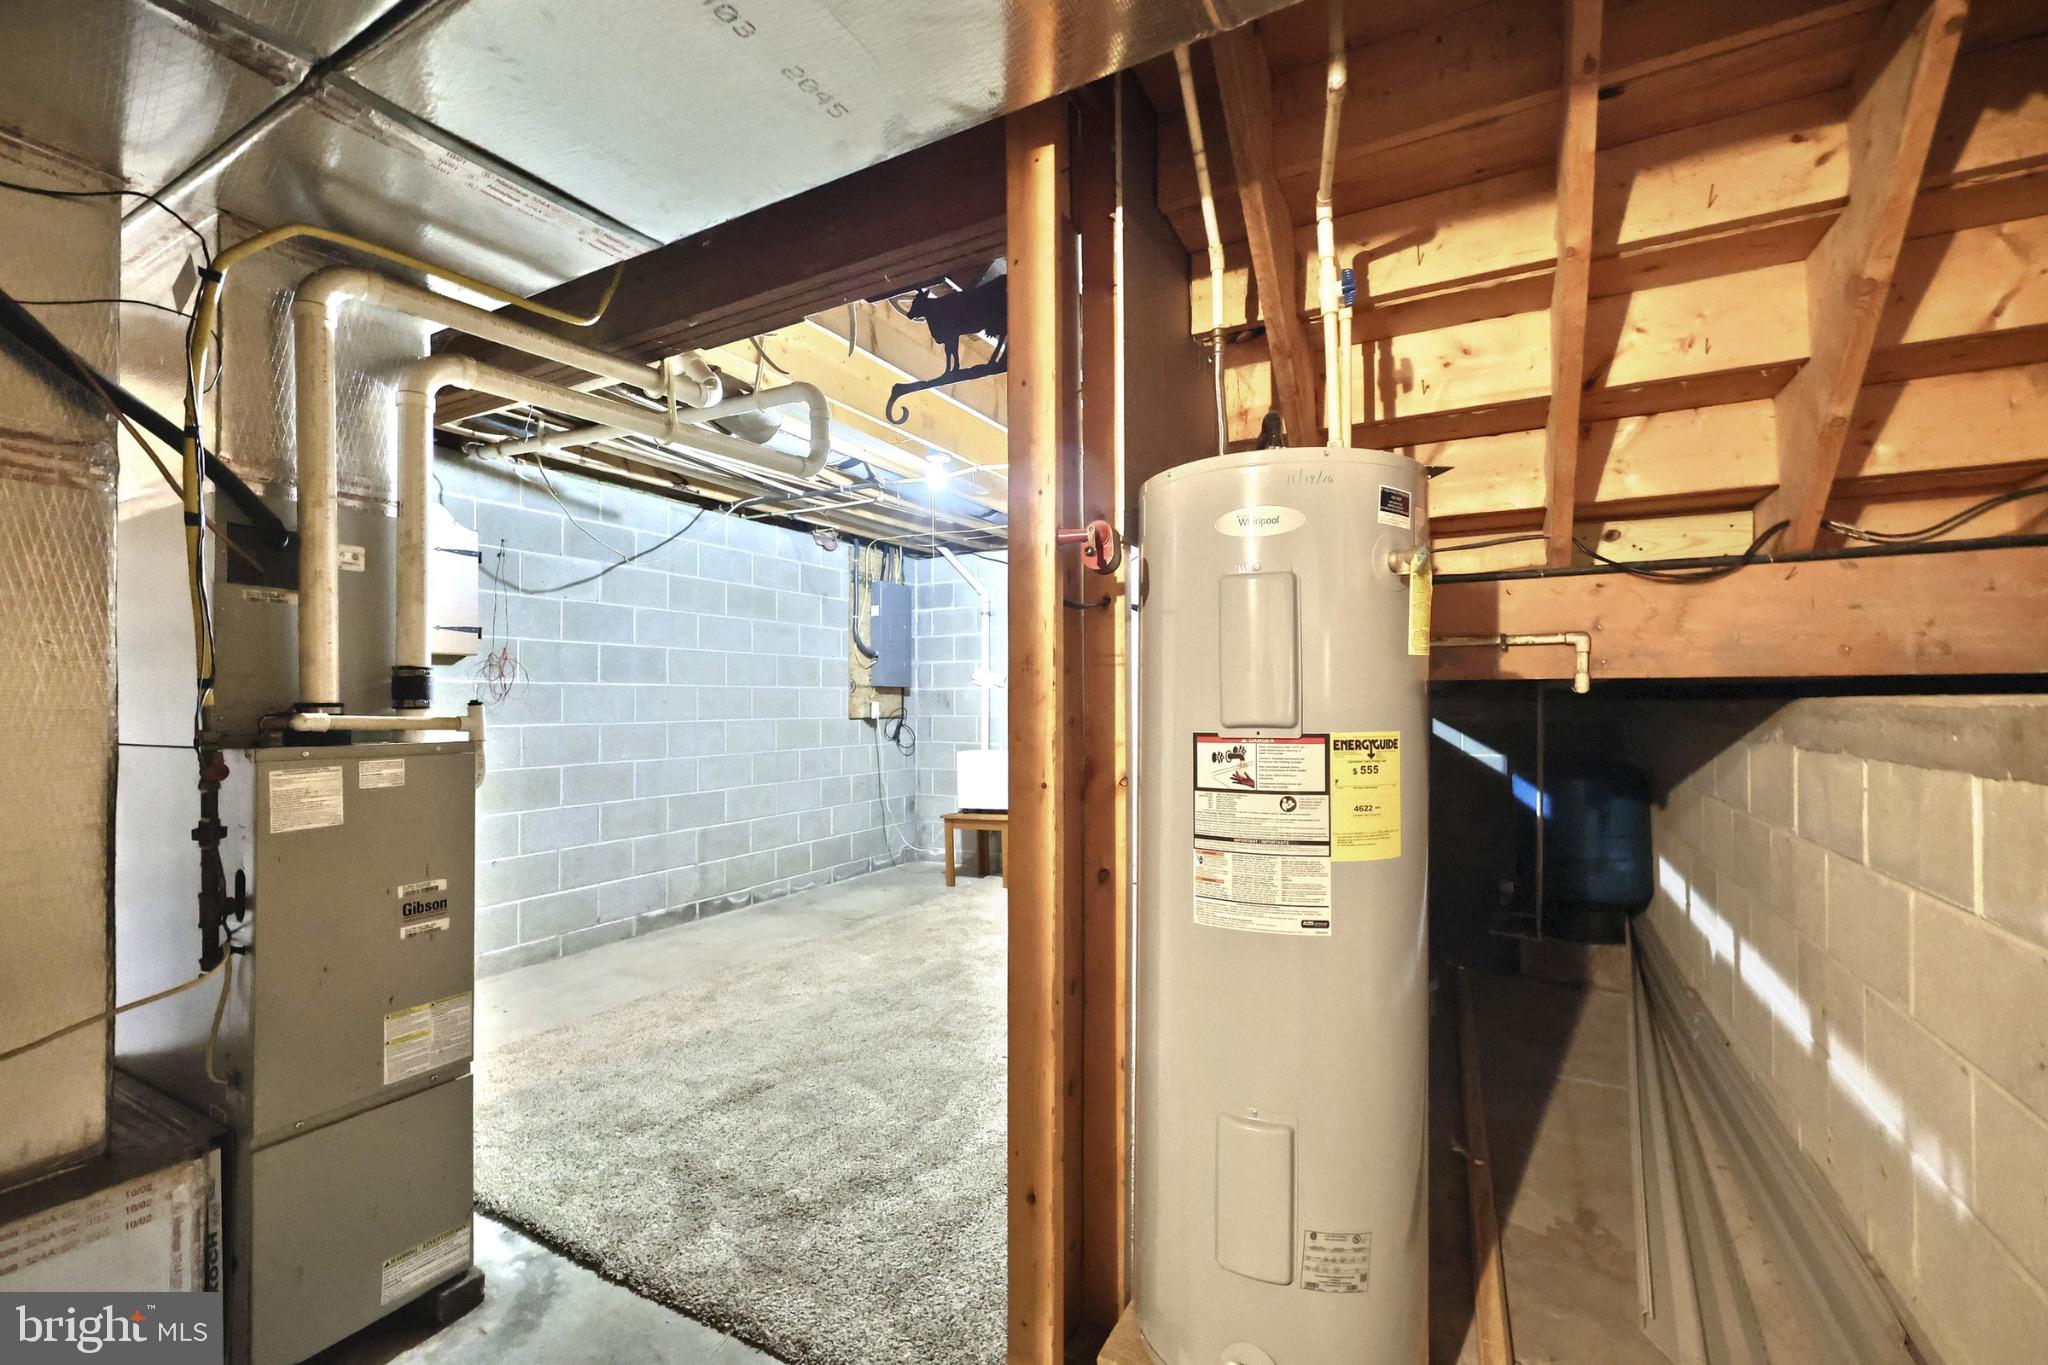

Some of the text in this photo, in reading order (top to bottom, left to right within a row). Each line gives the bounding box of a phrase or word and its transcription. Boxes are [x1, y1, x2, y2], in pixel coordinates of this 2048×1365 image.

[781, 65, 849, 118] 2045
[1237, 514, 1280, 527] Wirlpool
[1333, 739, 1399, 752] ENERGYGUIDE
[1360, 765, 1379, 775] 555
[1353, 804, 1373, 812] 4622
[403, 899, 448, 916] Gibson
